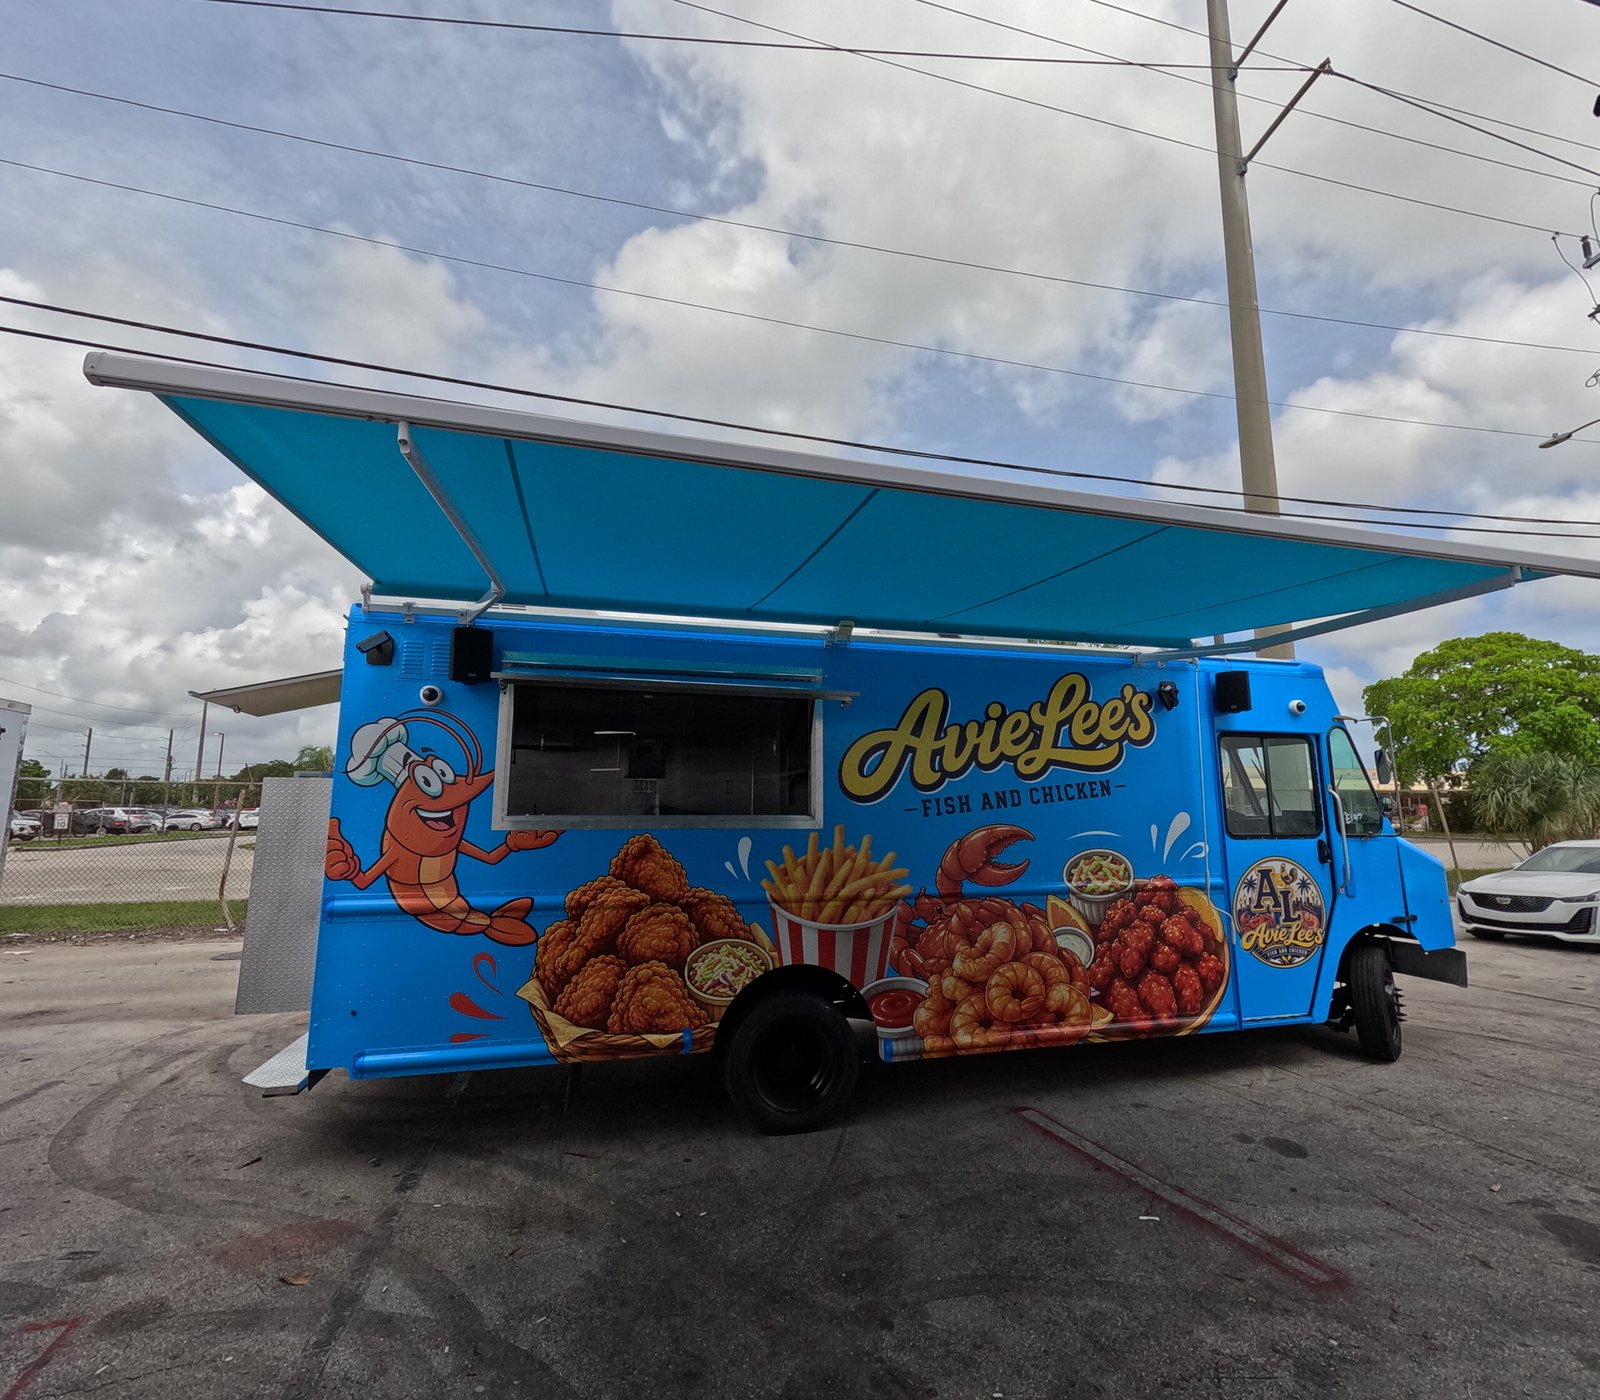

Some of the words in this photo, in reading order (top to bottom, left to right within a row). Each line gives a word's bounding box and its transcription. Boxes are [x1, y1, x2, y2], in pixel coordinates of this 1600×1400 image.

[921, 795, 972, 817] FISH
[981, 789, 1021, 811] AND
[1029, 780, 1112, 805] CHICKEN
